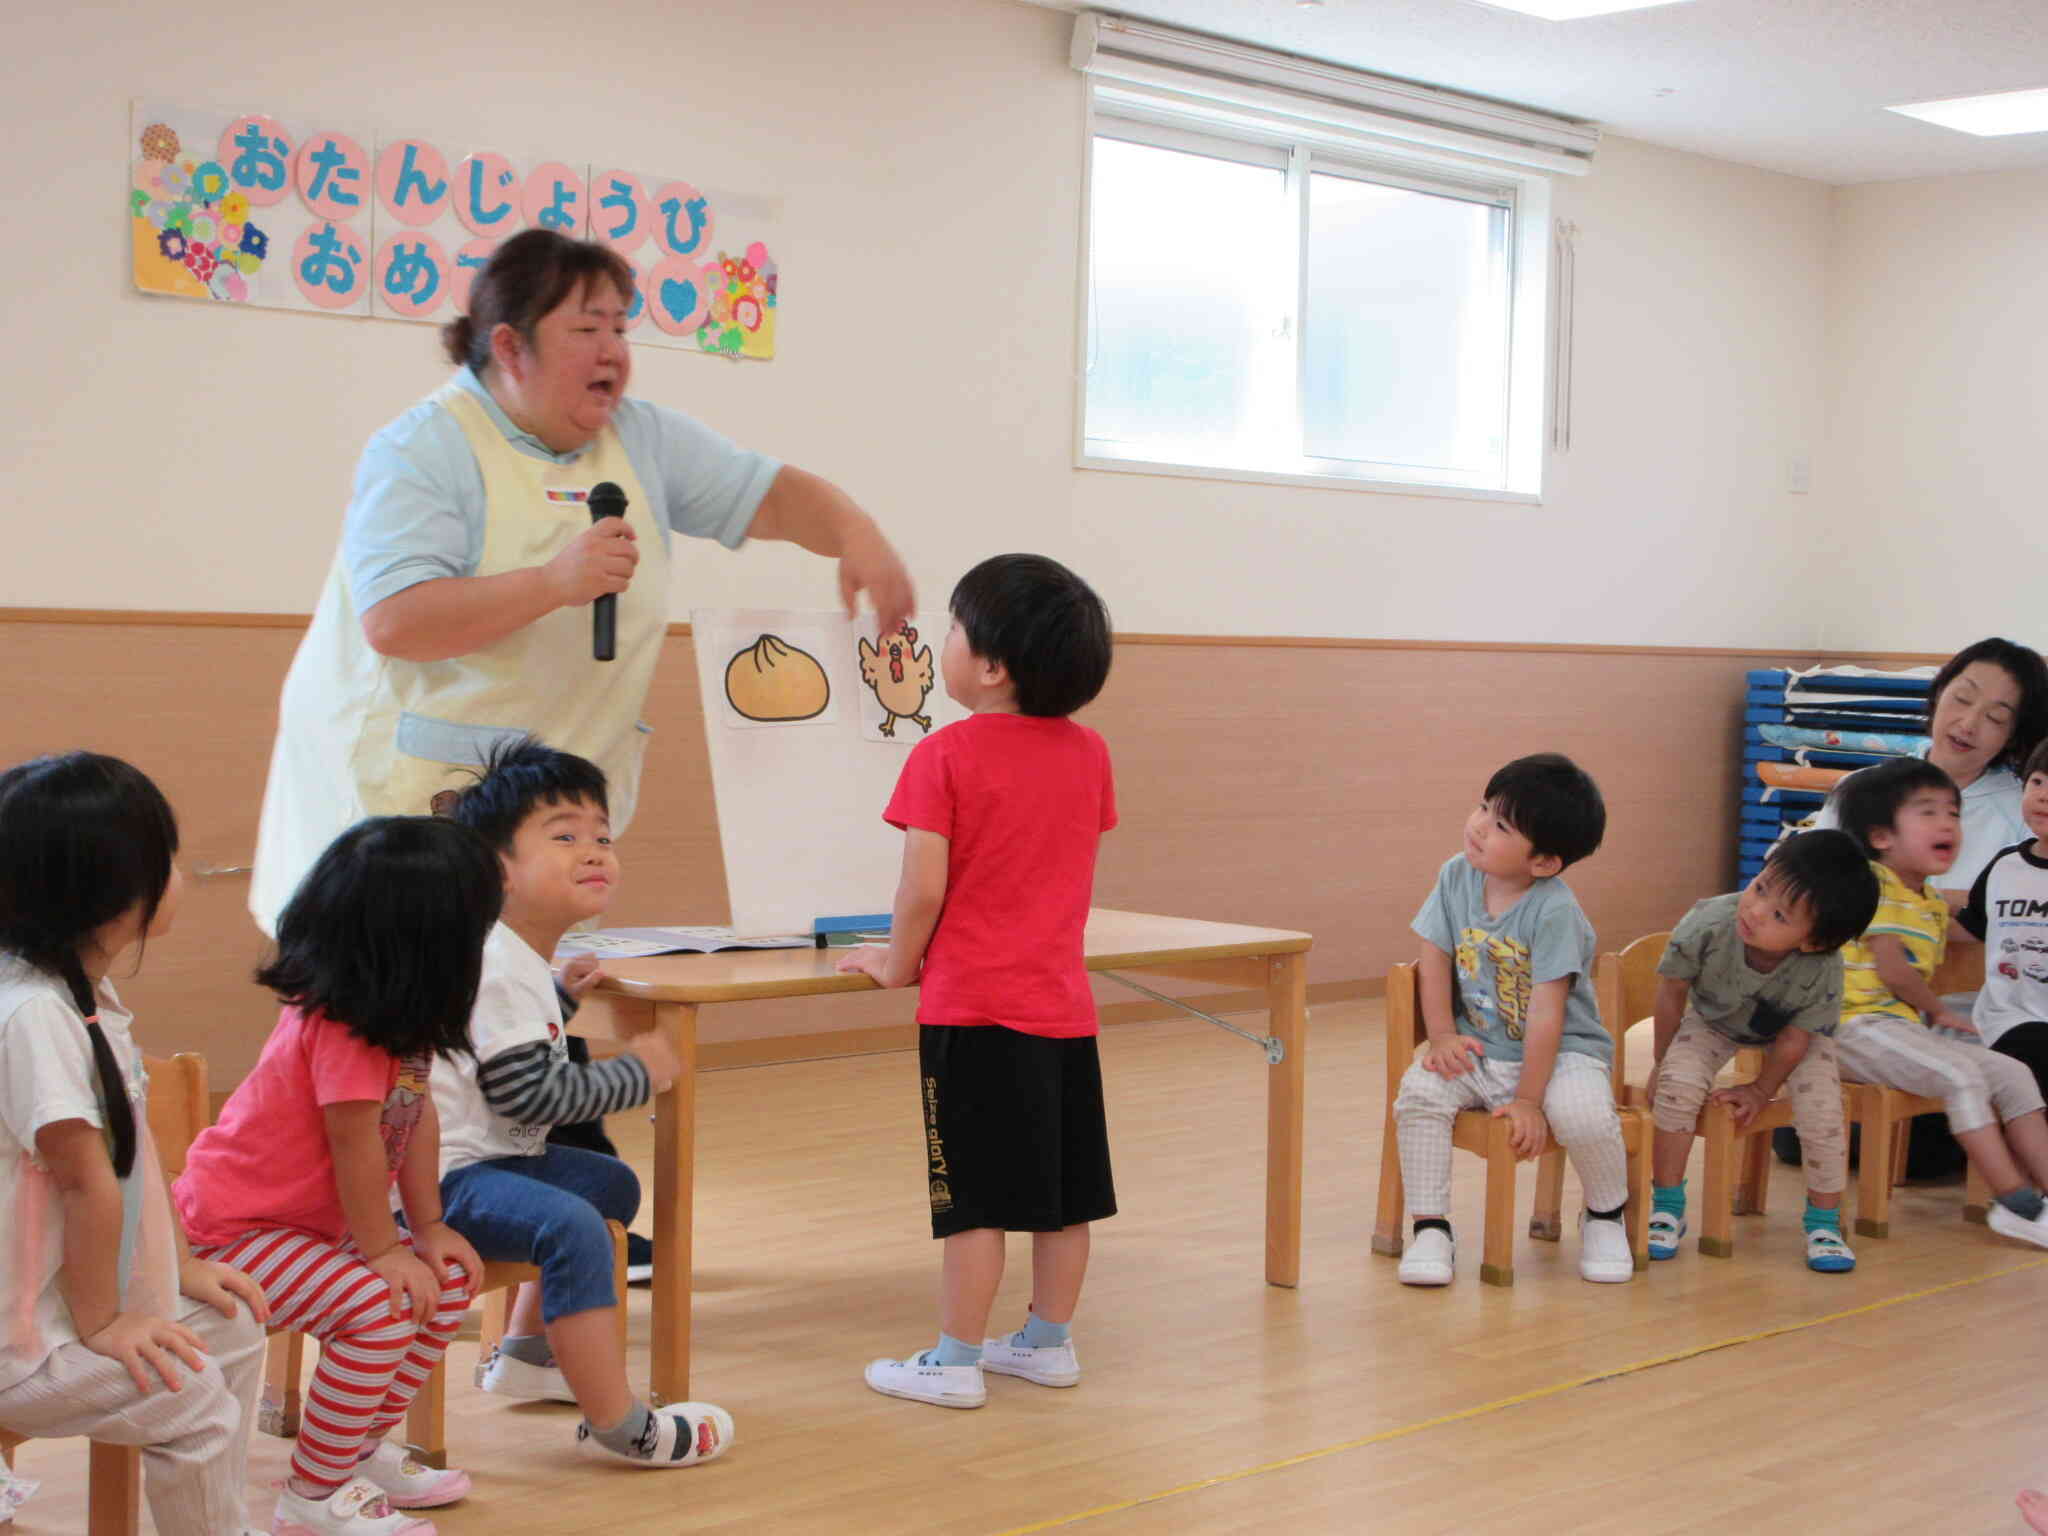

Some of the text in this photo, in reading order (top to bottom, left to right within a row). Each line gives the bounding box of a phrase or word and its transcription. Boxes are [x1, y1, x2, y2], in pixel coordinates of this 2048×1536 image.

[231, 124, 708, 255] おたんじょうび
